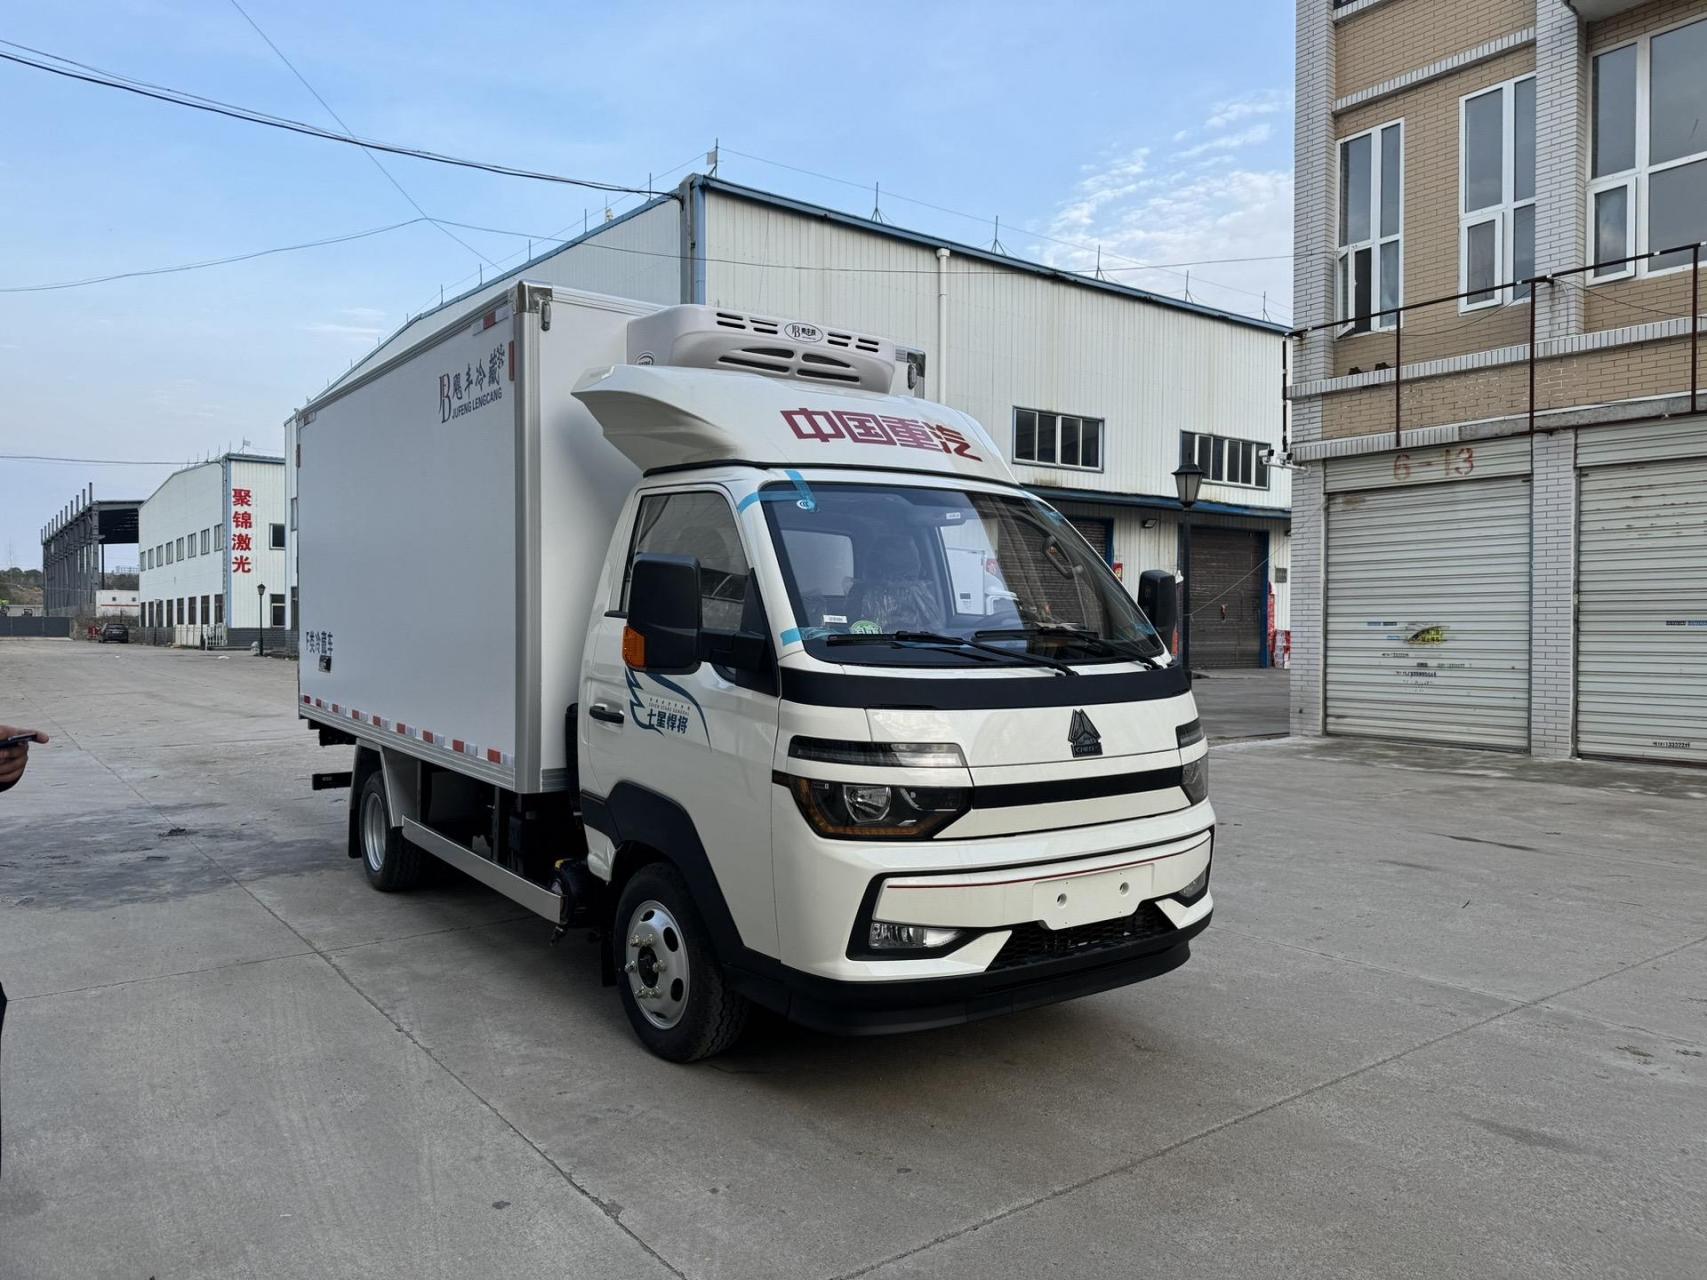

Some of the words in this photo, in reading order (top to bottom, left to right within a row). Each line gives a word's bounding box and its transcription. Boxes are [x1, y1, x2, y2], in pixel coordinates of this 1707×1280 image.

[452, 401, 472, 420] JUFENG
[780, 407, 984, 462] 中国重汽
[231, 488, 253, 574] 聚锦激光
[647, 707, 690, 735] 七星悍将
